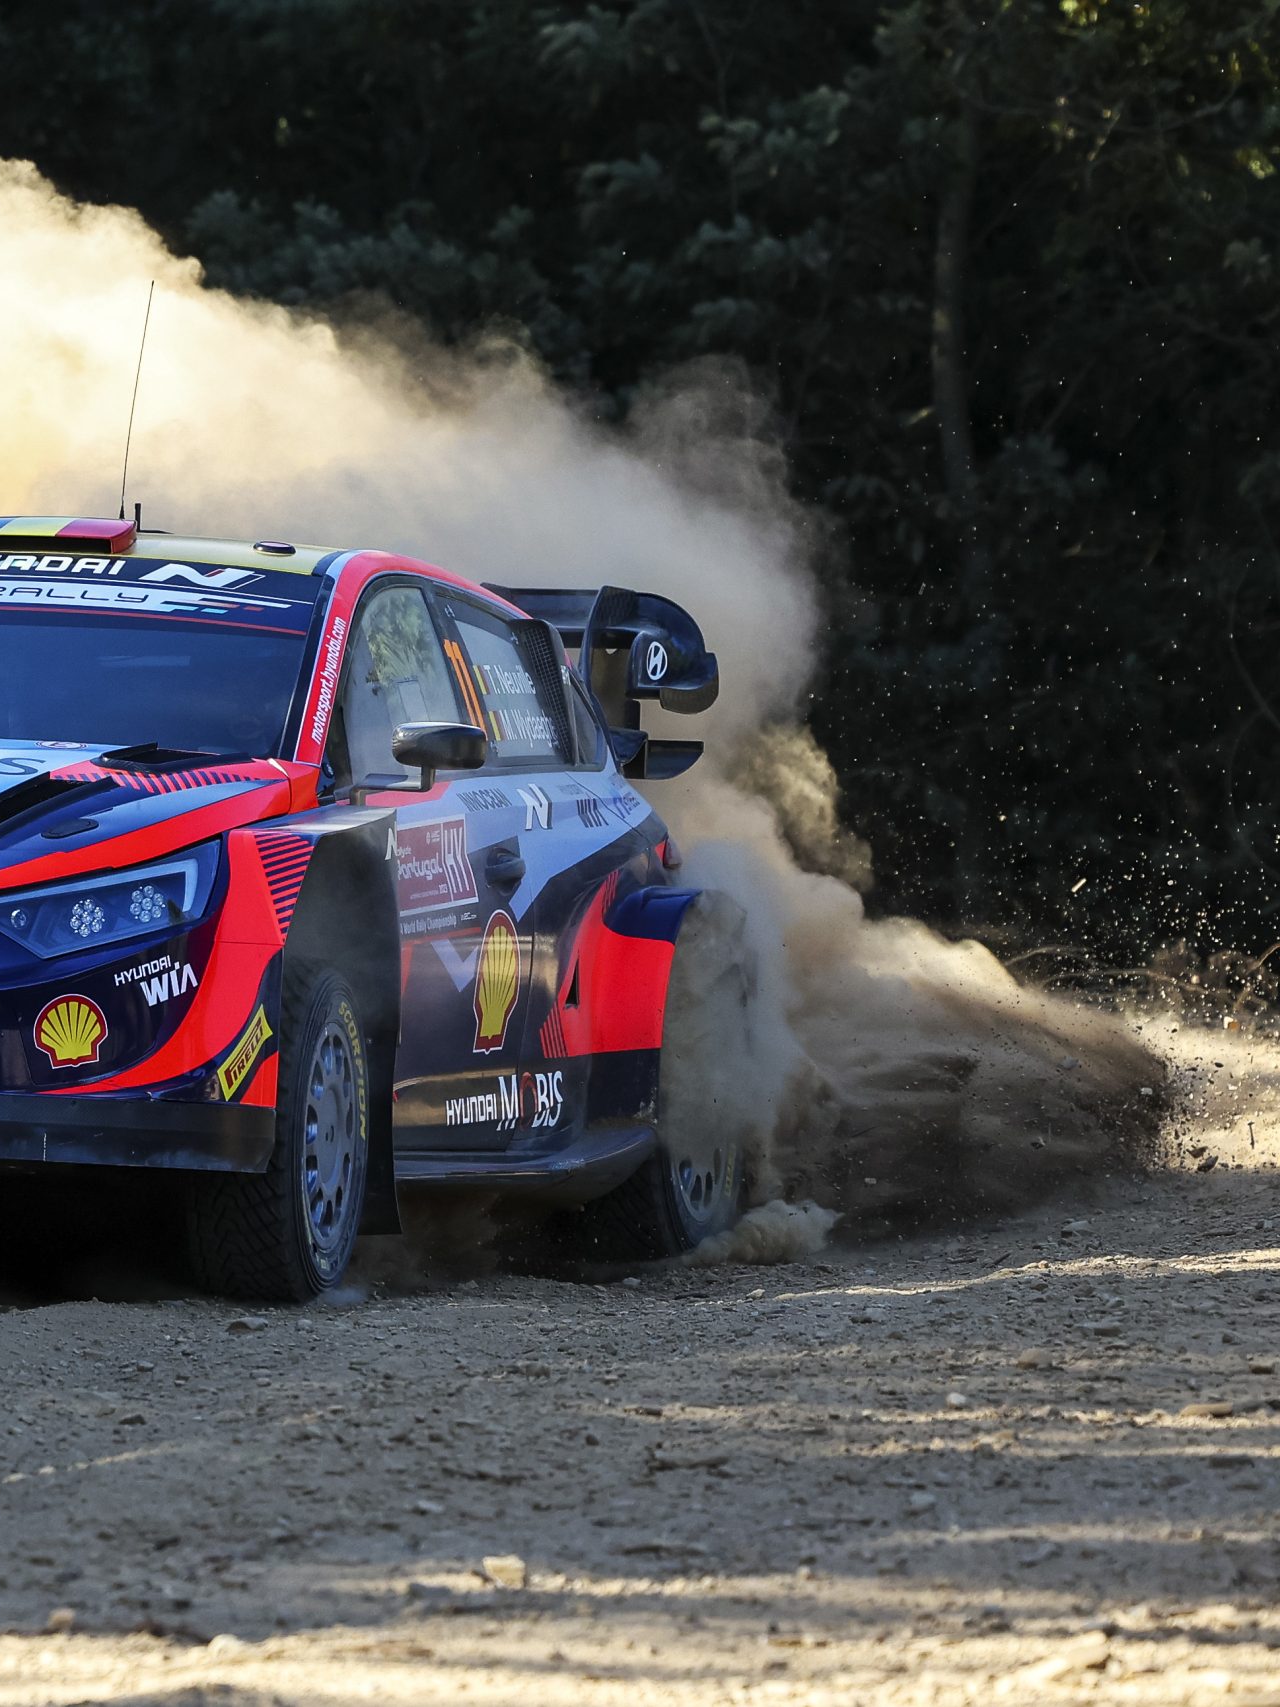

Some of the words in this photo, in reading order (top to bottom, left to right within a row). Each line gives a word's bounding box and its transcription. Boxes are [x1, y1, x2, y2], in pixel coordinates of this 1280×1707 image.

[311, 616, 347, 745] motorsport.hyundai.com
[483, 664, 500, 694] T.
[444, 826, 470, 894] HY
[114, 955, 171, 987] HYUNDAI
[140, 962, 199, 1007] WIA
[223, 1016, 264, 1090] PIRELLI
[338, 1001, 366, 1141] SCORPION
[445, 1093, 498, 1127] HYUNDAI
[496, 1070, 564, 1132] MOBIS
